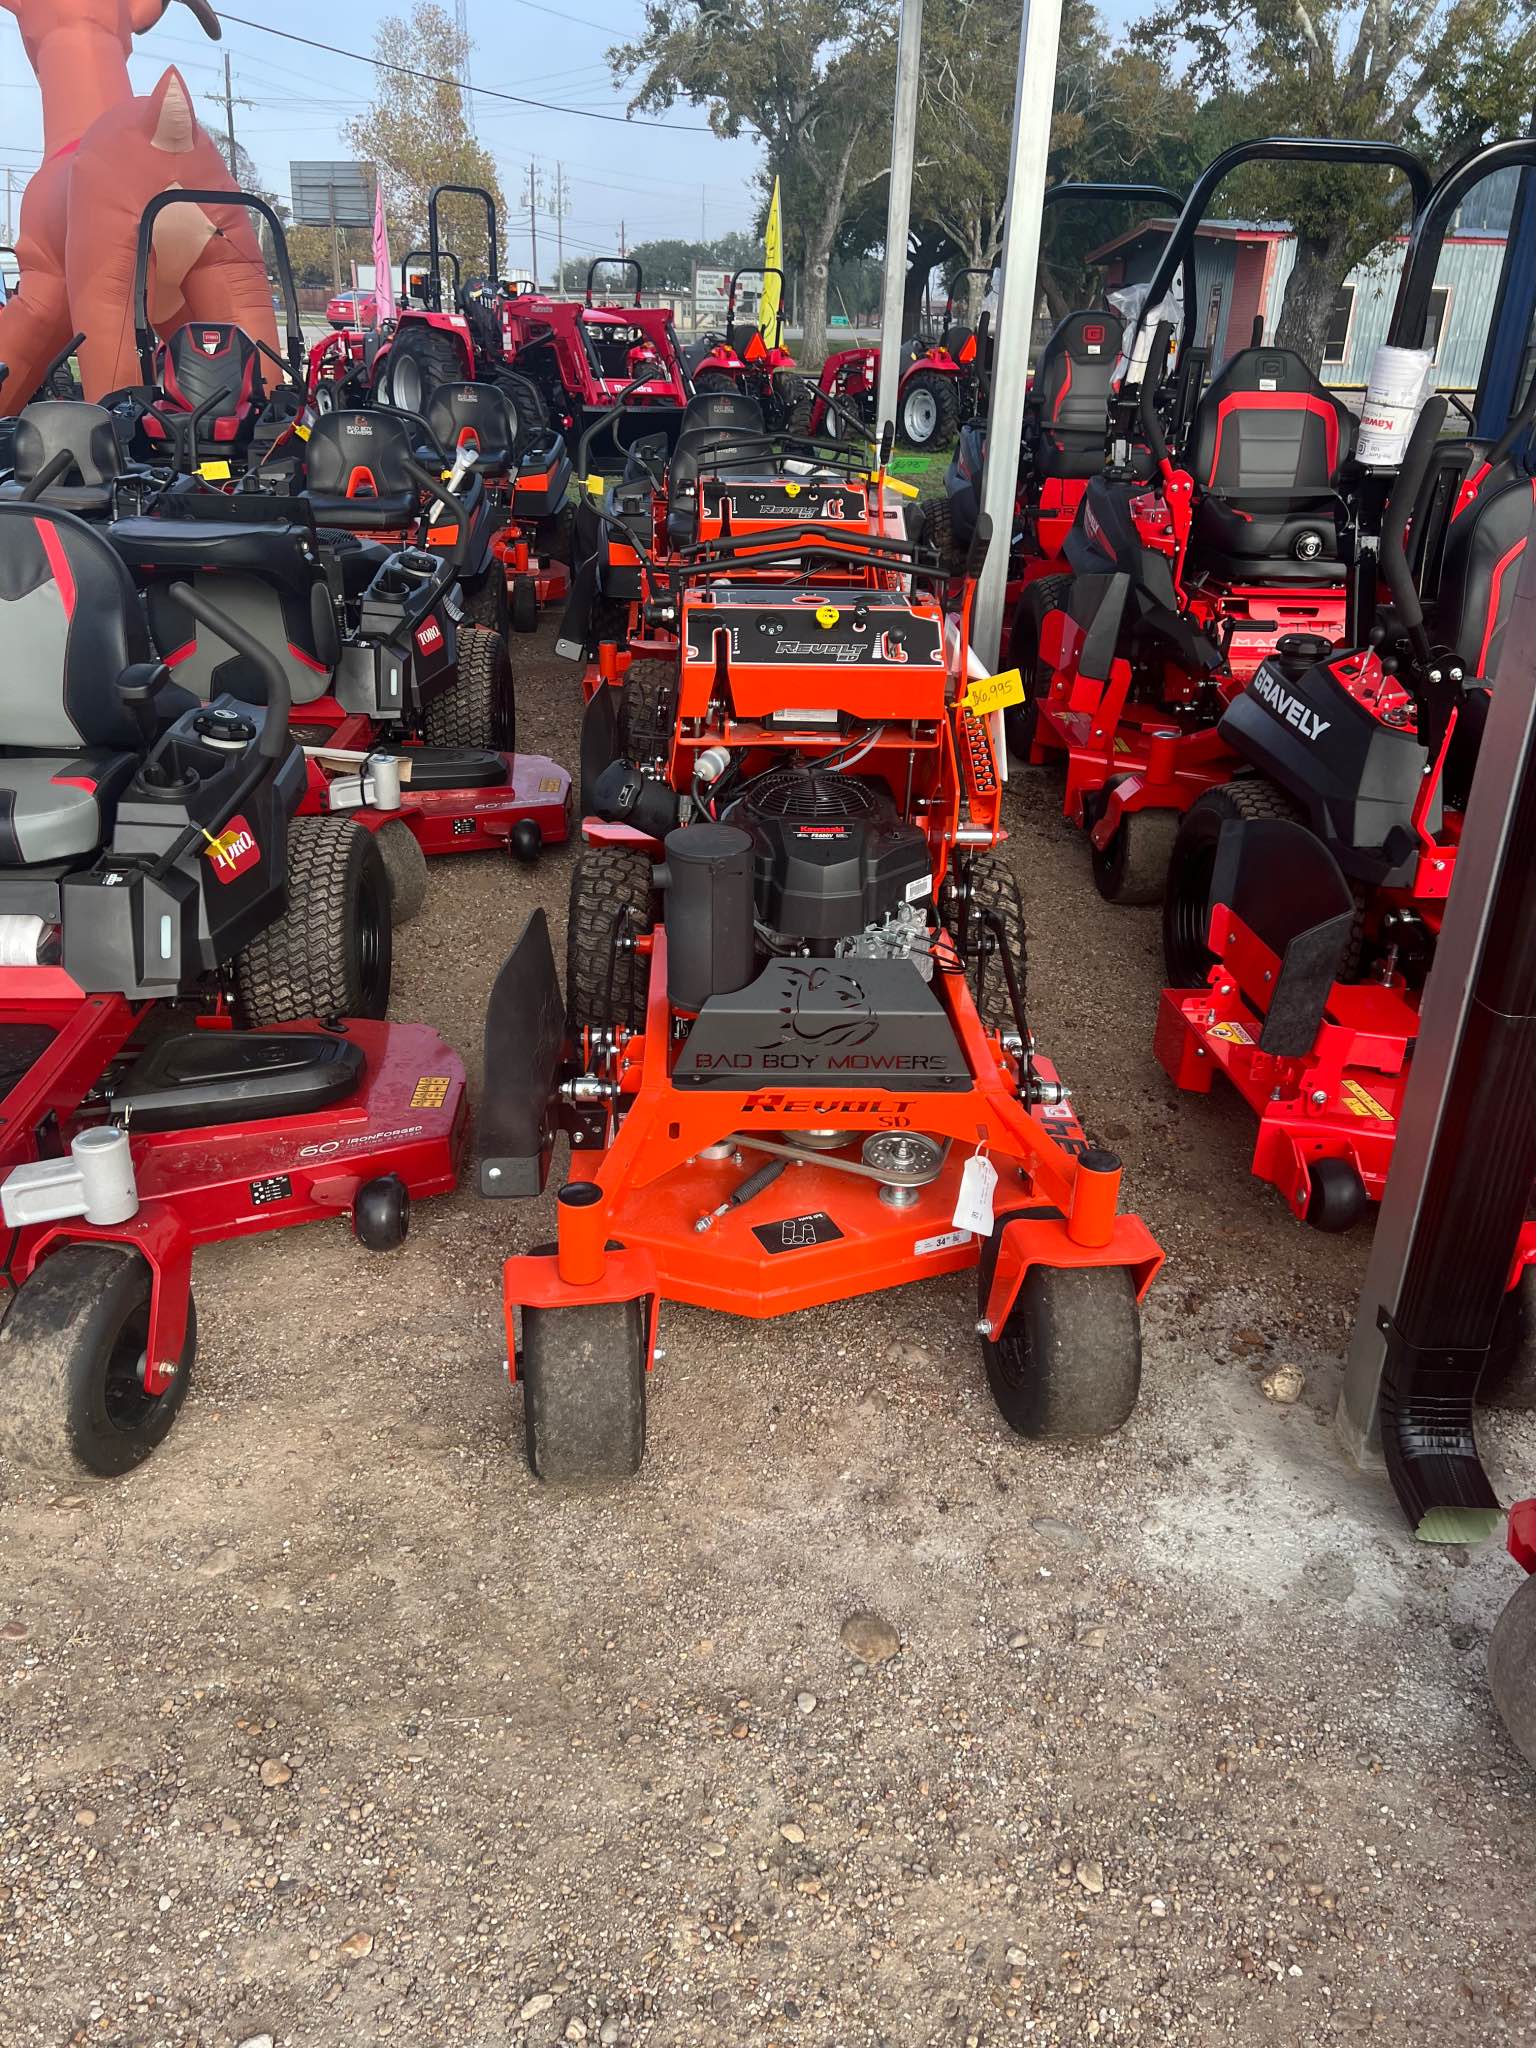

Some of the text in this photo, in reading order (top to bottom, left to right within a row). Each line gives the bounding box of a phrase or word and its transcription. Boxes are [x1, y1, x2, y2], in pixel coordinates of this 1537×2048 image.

[418, 625, 440, 645] TORO
[1254, 666, 1331, 741] GRAVELY
[1232, 1024, 1252, 1043] DANGER
[696, 1054, 949, 1070] BAD BOY MOWERS
[879, 1116, 911, 1128] SD
